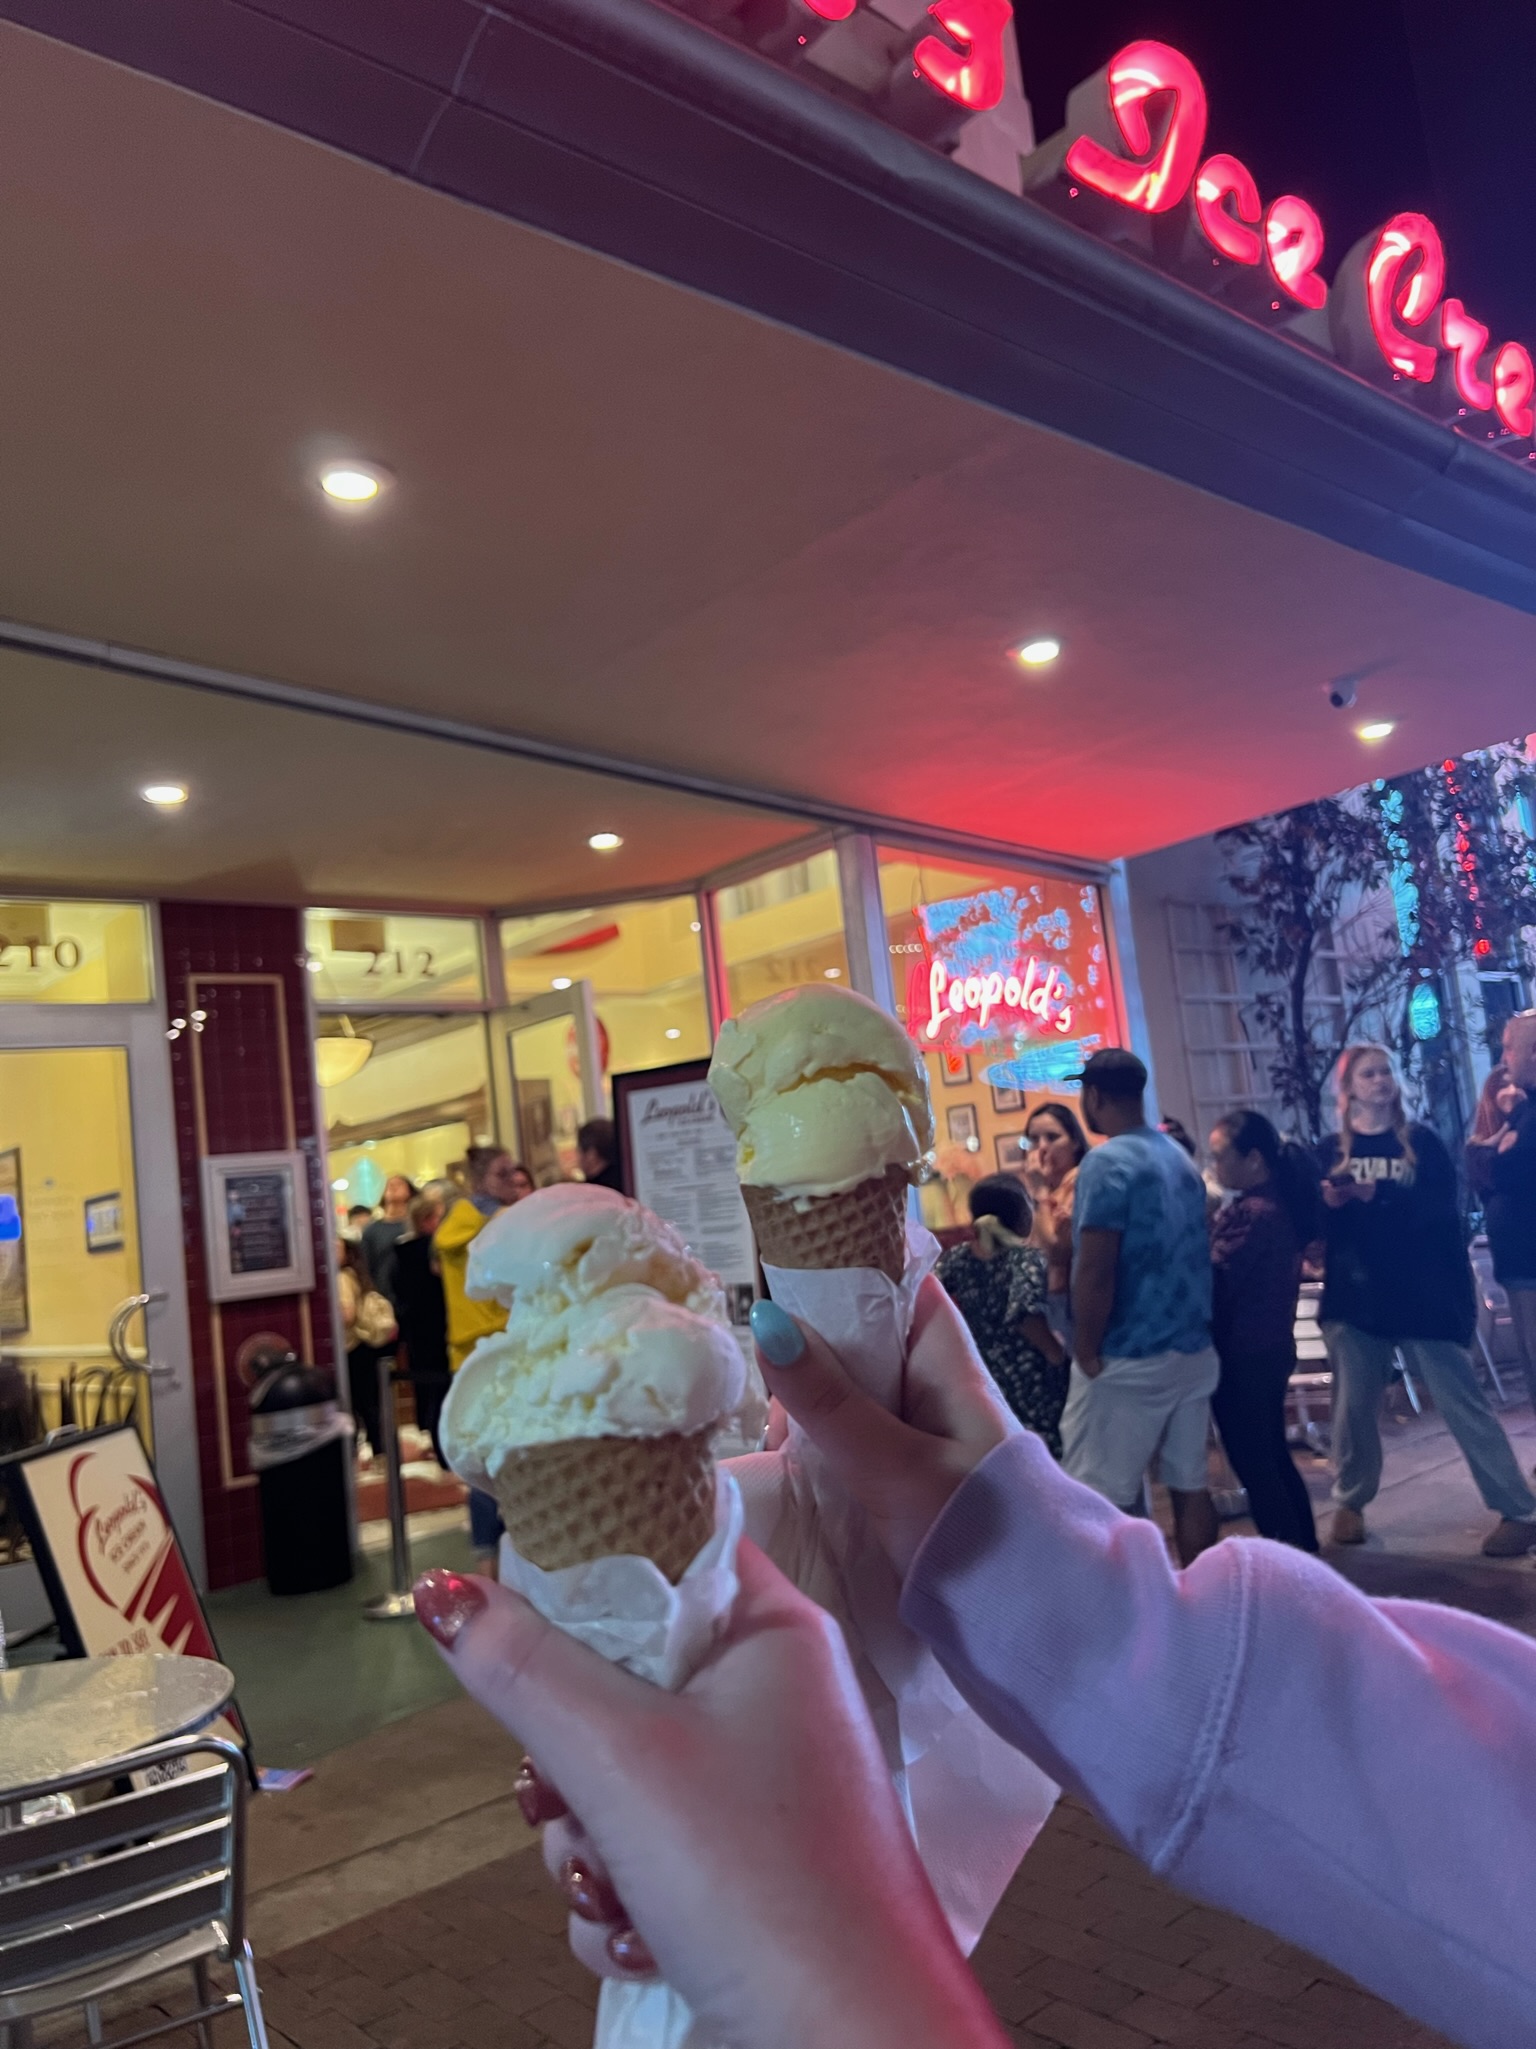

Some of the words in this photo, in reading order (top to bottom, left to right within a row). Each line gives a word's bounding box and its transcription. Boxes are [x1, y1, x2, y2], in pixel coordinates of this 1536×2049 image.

[1066, 40, 1326, 309] Ice
[361, 945, 436, 977] 212
[926, 955, 1076, 1039] Leopold's
